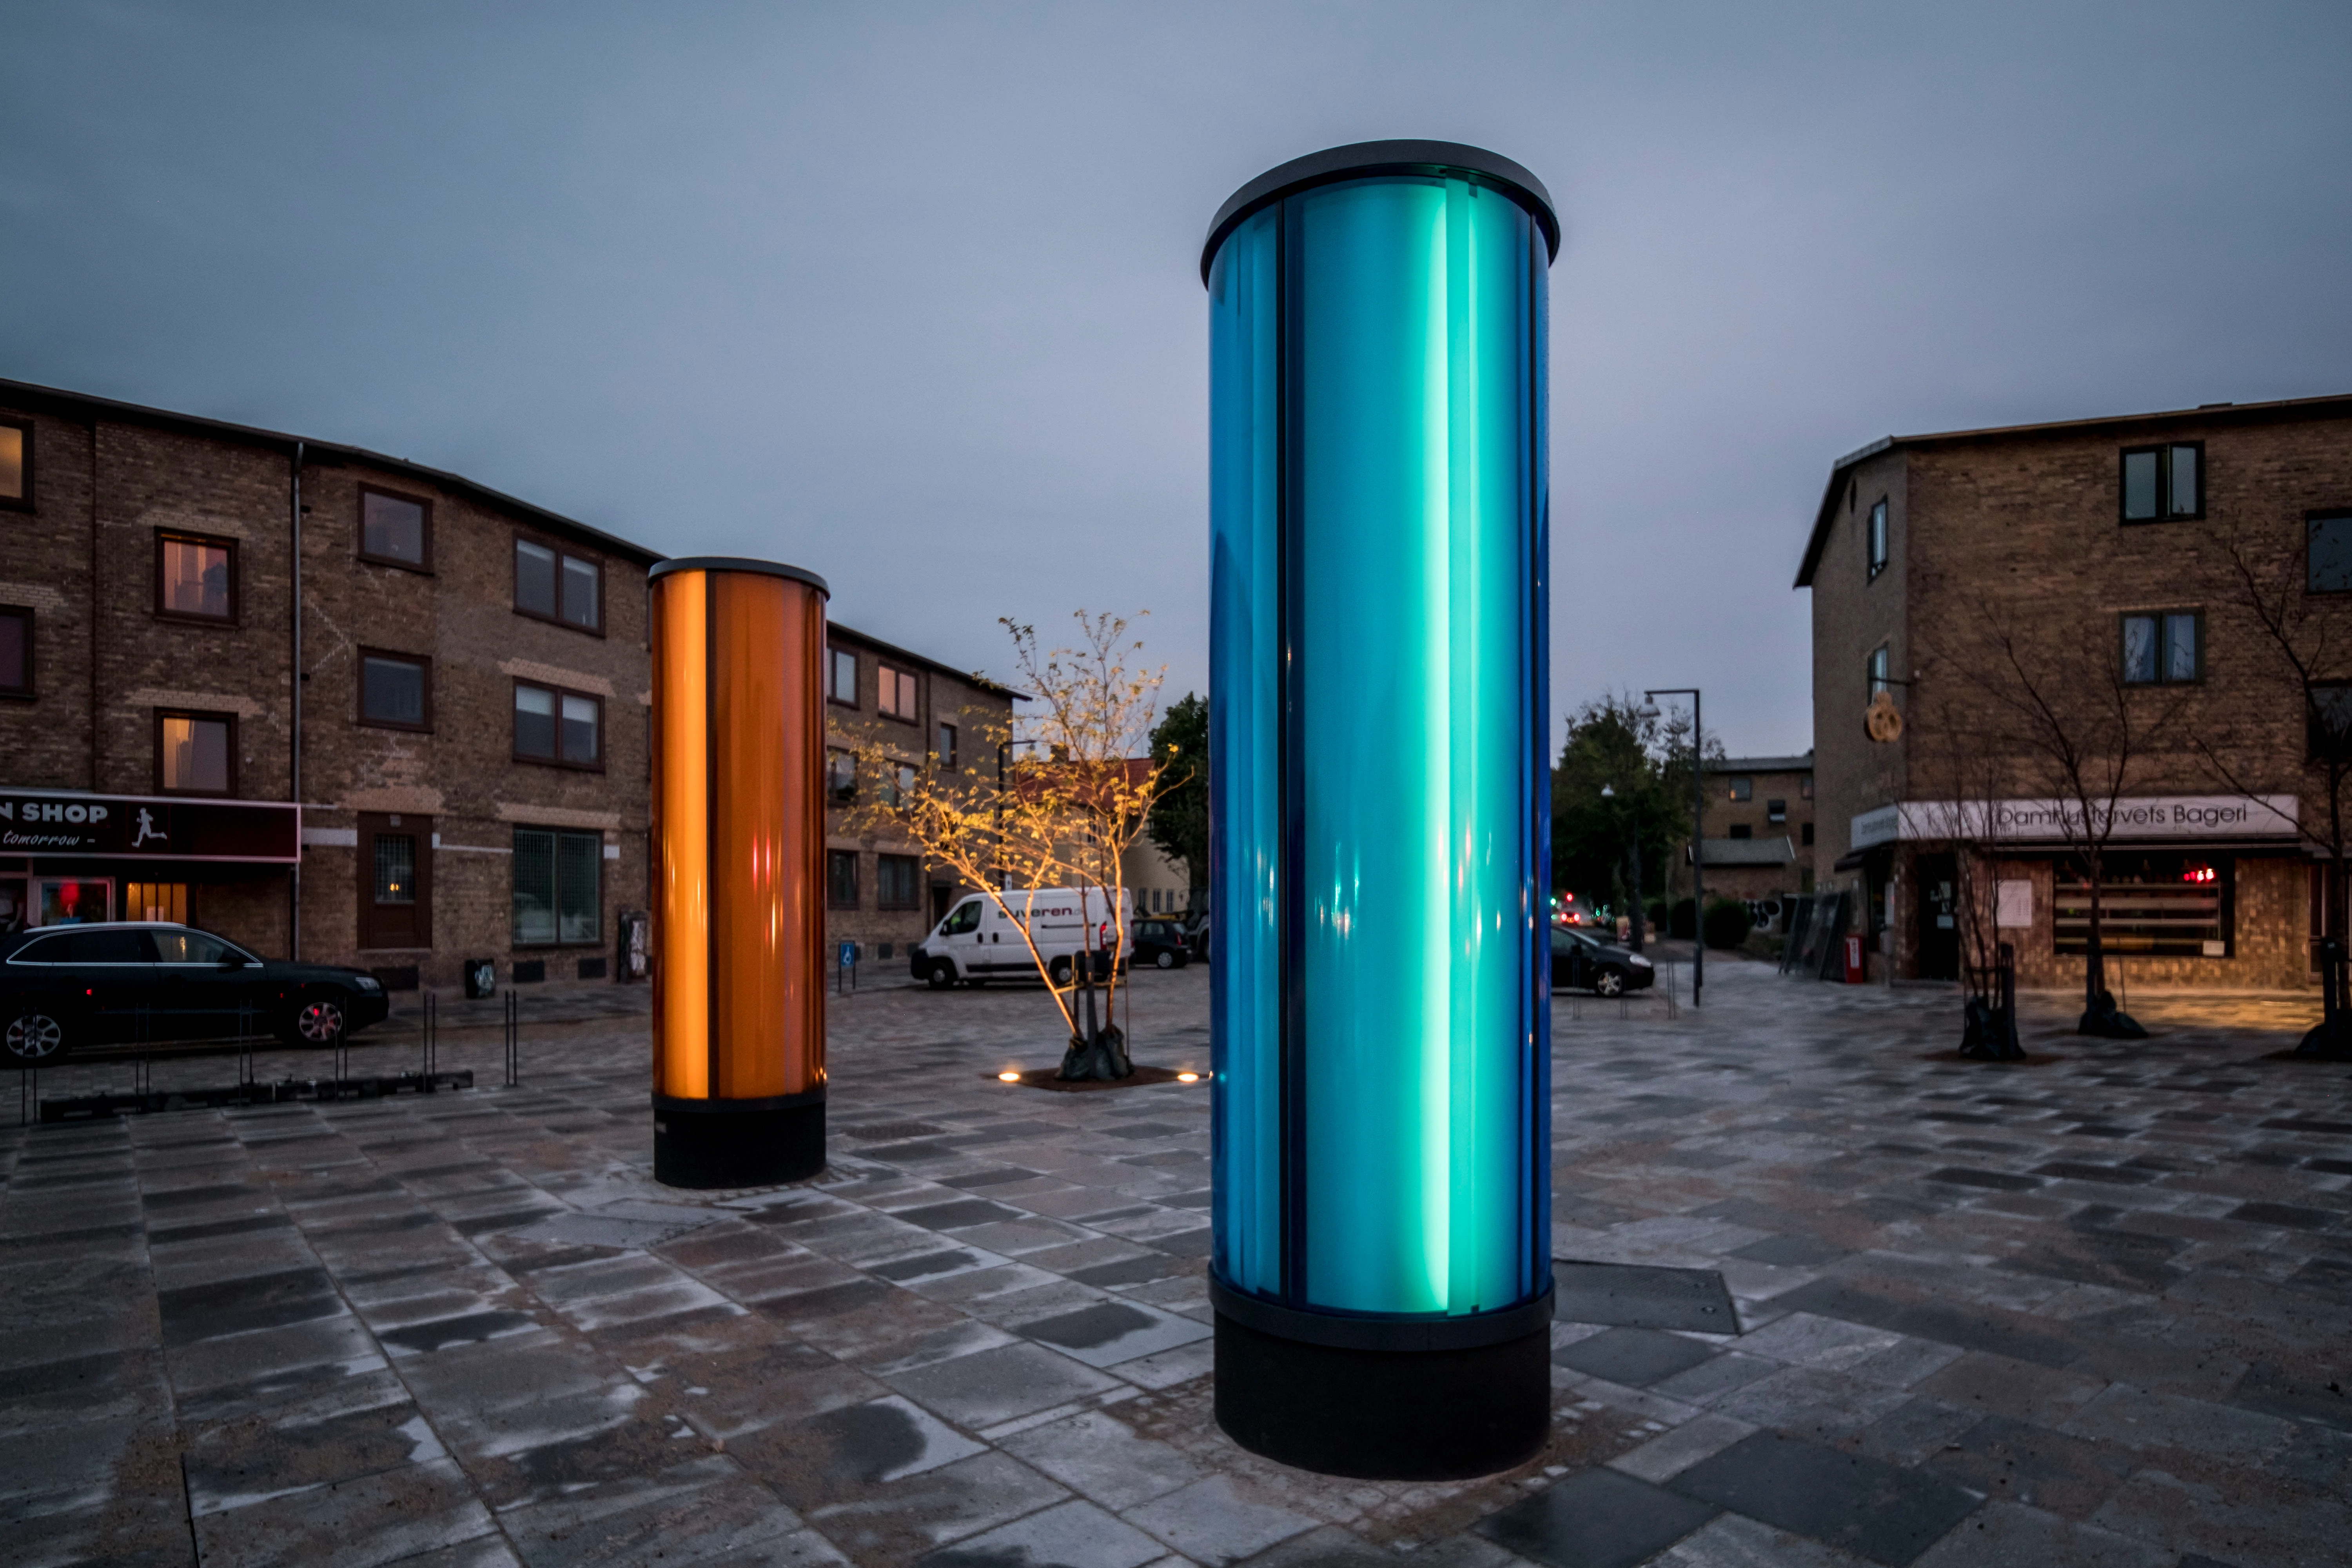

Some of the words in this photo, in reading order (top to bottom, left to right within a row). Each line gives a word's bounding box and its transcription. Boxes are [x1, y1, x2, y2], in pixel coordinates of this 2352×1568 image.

[22, 802, 108, 824] SHOP
[2174, 804, 2246, 828] Bageri
[3, 829, 80, 846] tomorrow
